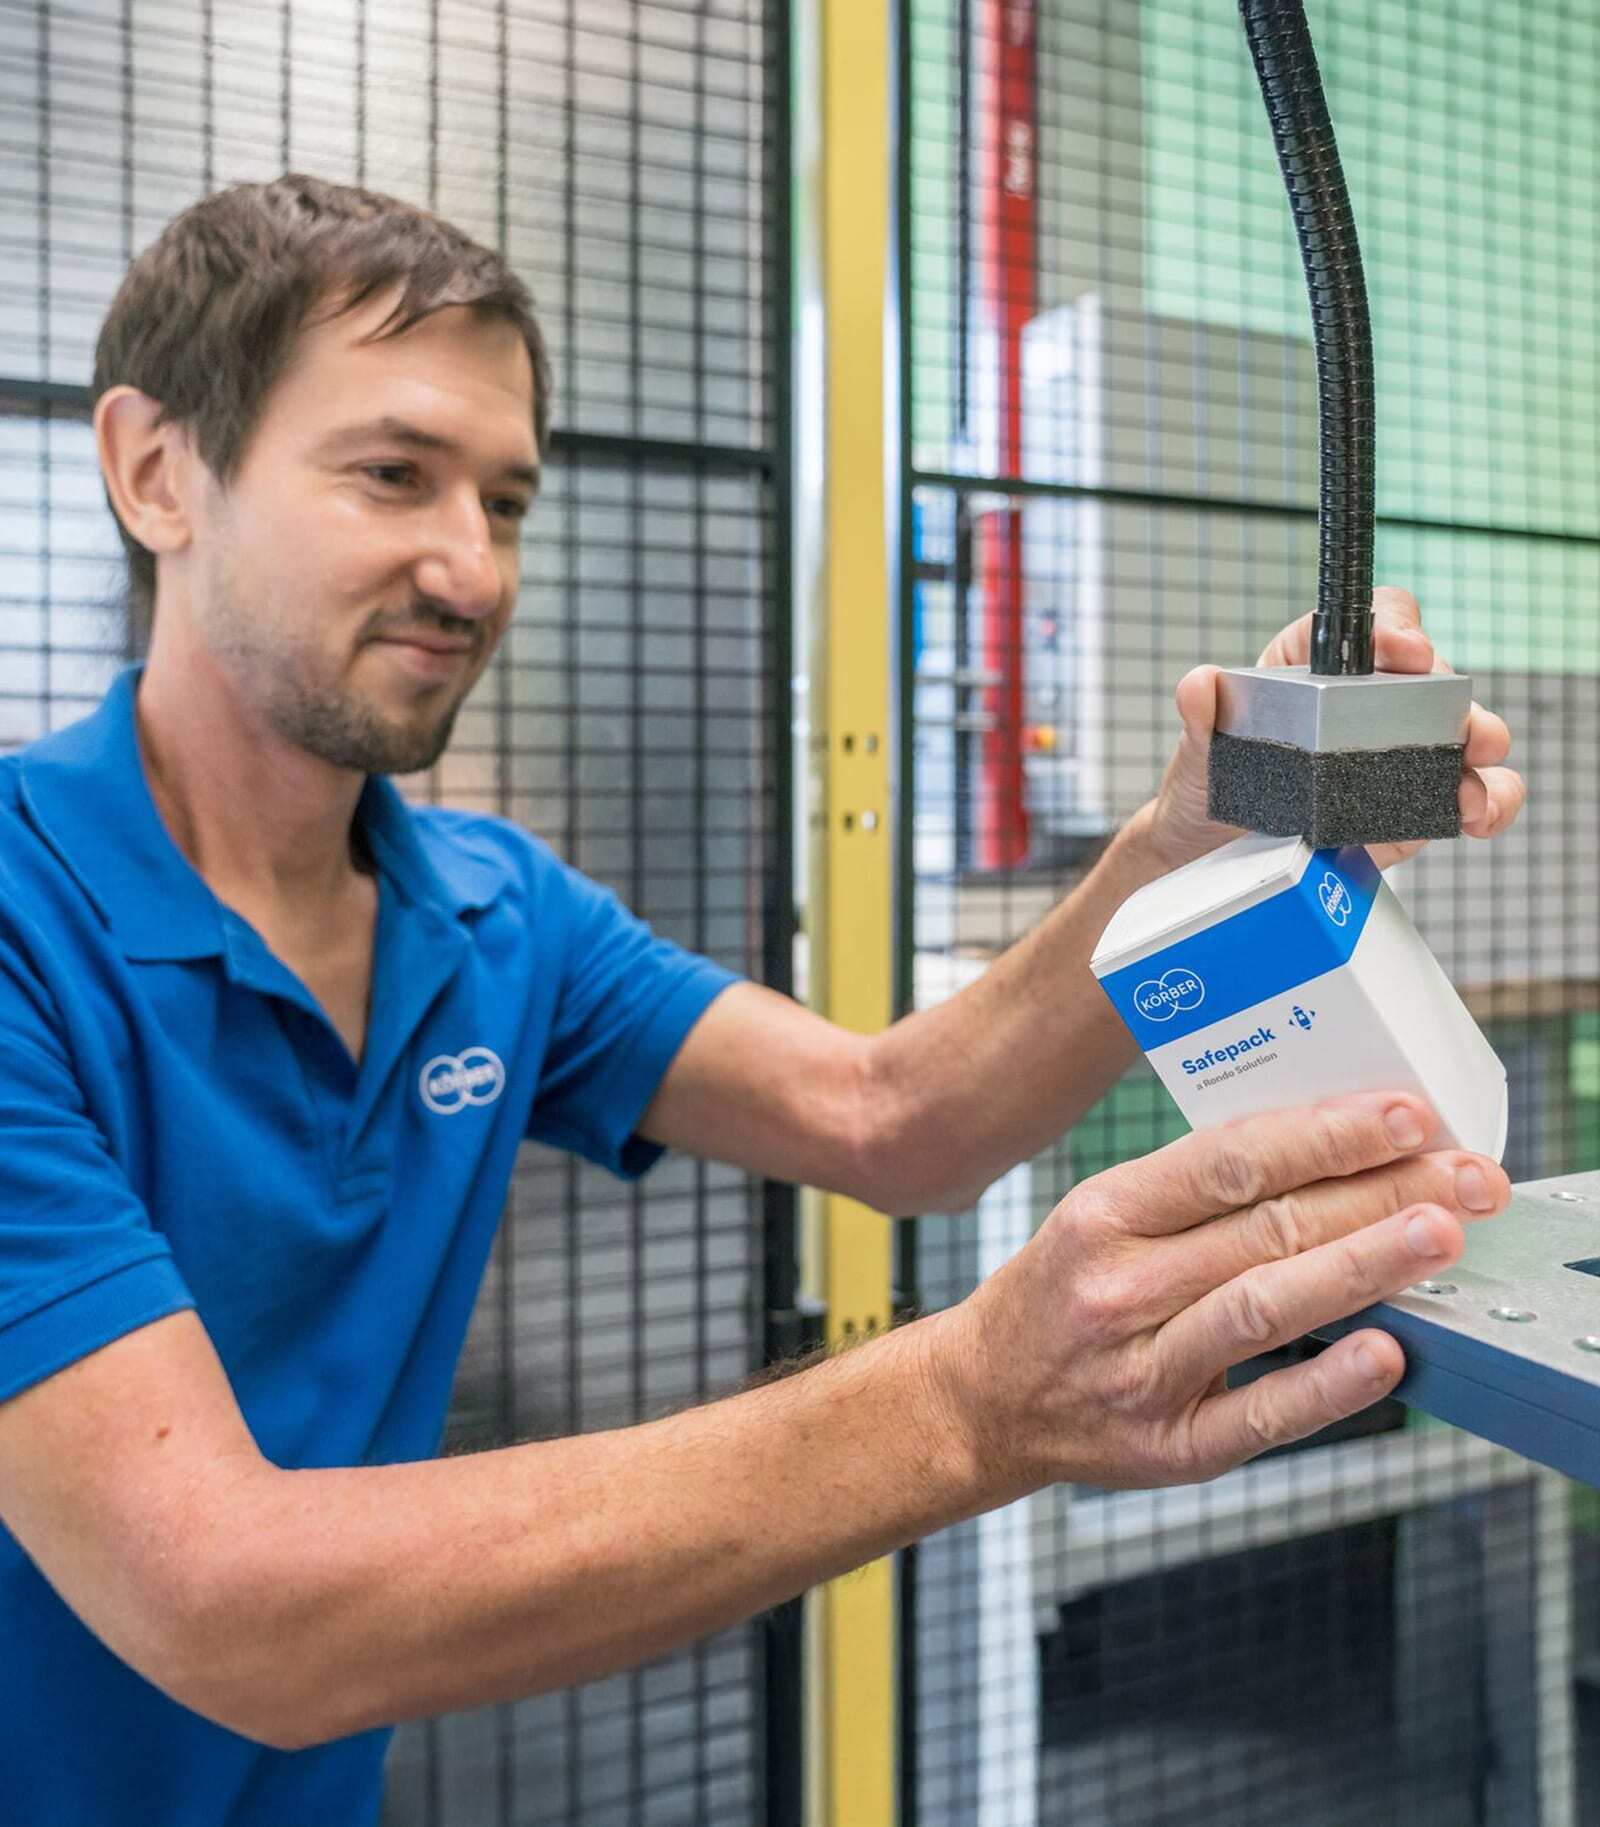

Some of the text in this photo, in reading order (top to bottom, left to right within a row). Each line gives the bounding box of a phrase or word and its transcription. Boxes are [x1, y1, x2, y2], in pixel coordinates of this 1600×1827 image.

[1140, 979, 1199, 1011] KÖRBER
[1181, 1027, 1276, 1075] Safepack
[1203, 1069, 1235, 1087] Rondo
[1234, 1052, 1278, 1074] Solution
